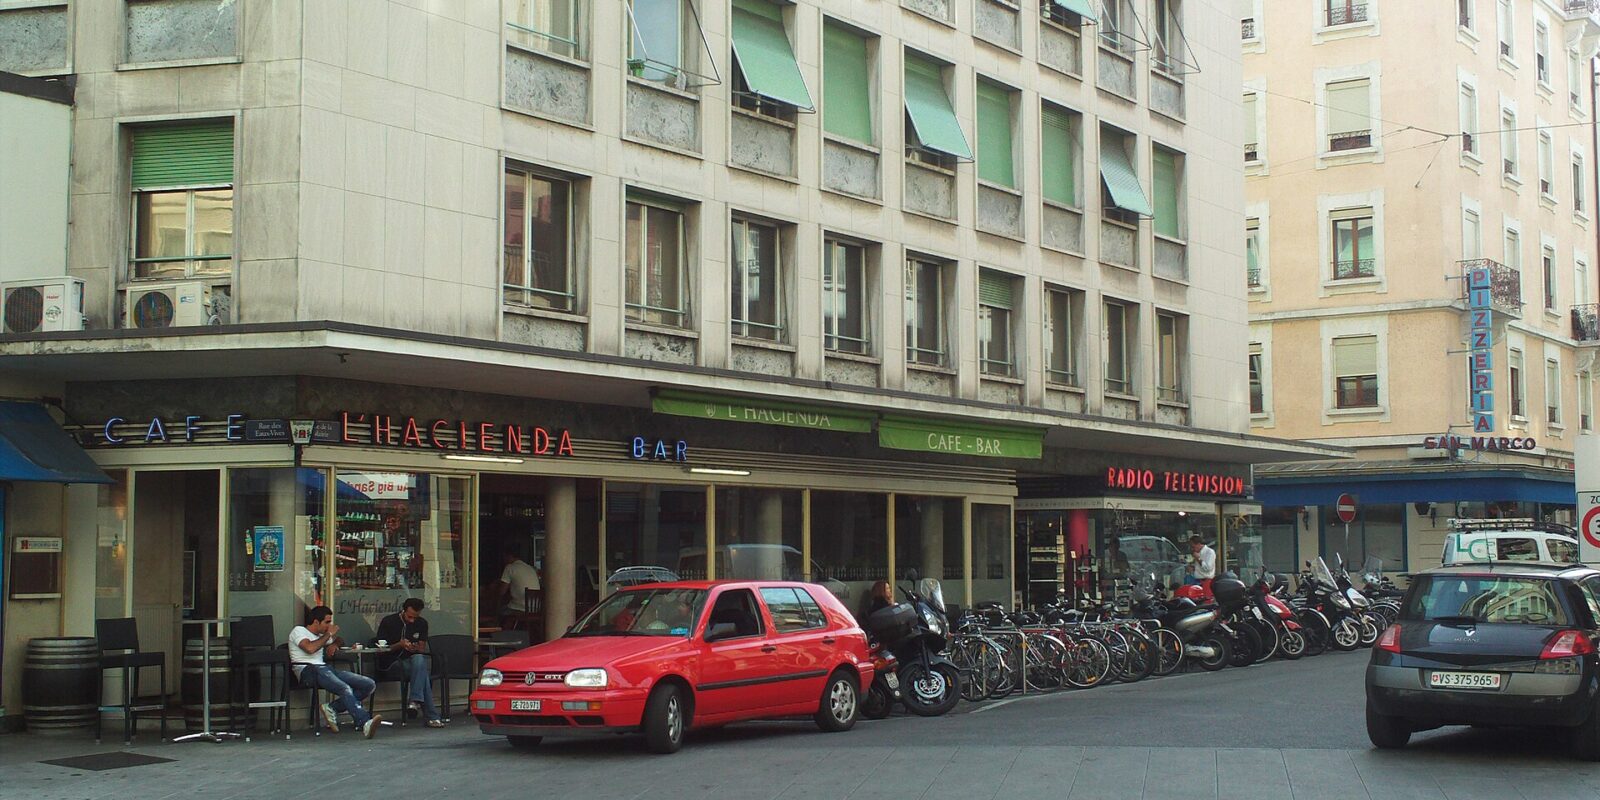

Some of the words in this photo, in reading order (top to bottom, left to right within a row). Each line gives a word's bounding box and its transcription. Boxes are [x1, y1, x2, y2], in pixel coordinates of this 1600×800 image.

[1473, 271, 1490, 431] PIZZERIA
[104, 413, 243, 443] CAFE
[255, 429, 285, 437] Eaux-Vives
[271, 421, 281, 429] des
[343, 411, 574, 456] L'HACIENDA
[633, 436, 687, 461] BAR
[927, 432, 962, 452] CAFE
[976, 437, 1002, 455] BAR
[1423, 436, 1461, 449] SAN
[1471, 436, 1537, 450] MARCO
[1107, 467, 1154, 490] RADIO
[1164, 472, 1244, 494] TELEVISION
